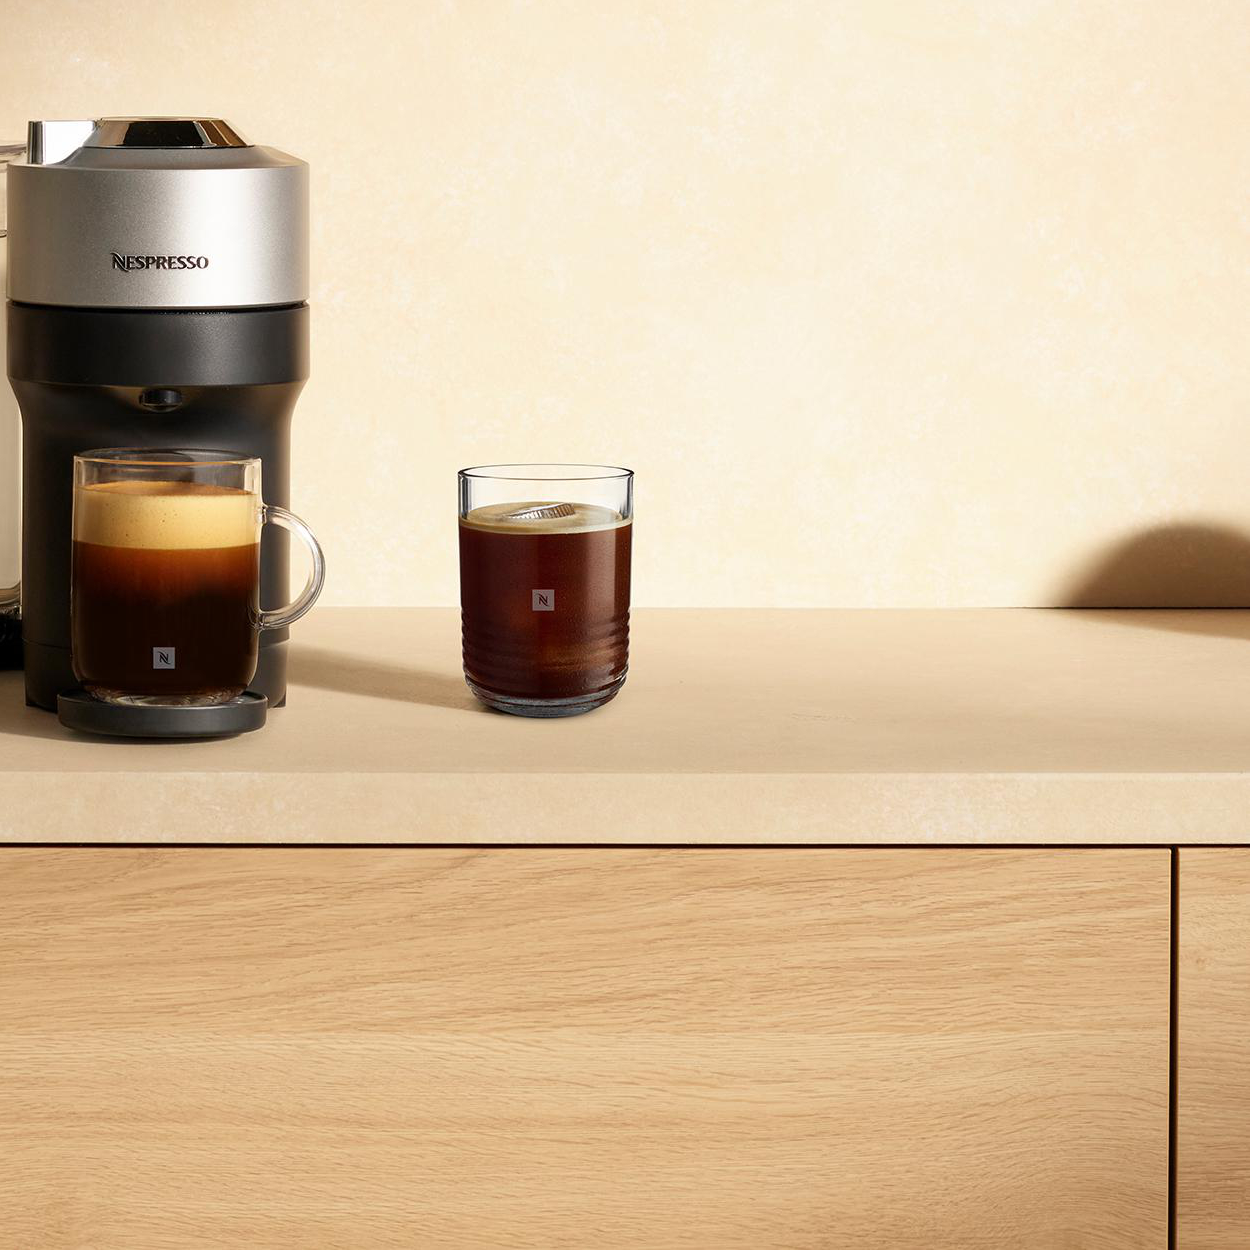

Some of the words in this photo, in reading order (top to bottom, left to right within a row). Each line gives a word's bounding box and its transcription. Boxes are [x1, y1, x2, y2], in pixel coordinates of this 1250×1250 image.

[110, 252, 210, 273] NESPRESSO
[536, 592, 550, 607] N
[157, 650, 171, 665] N
